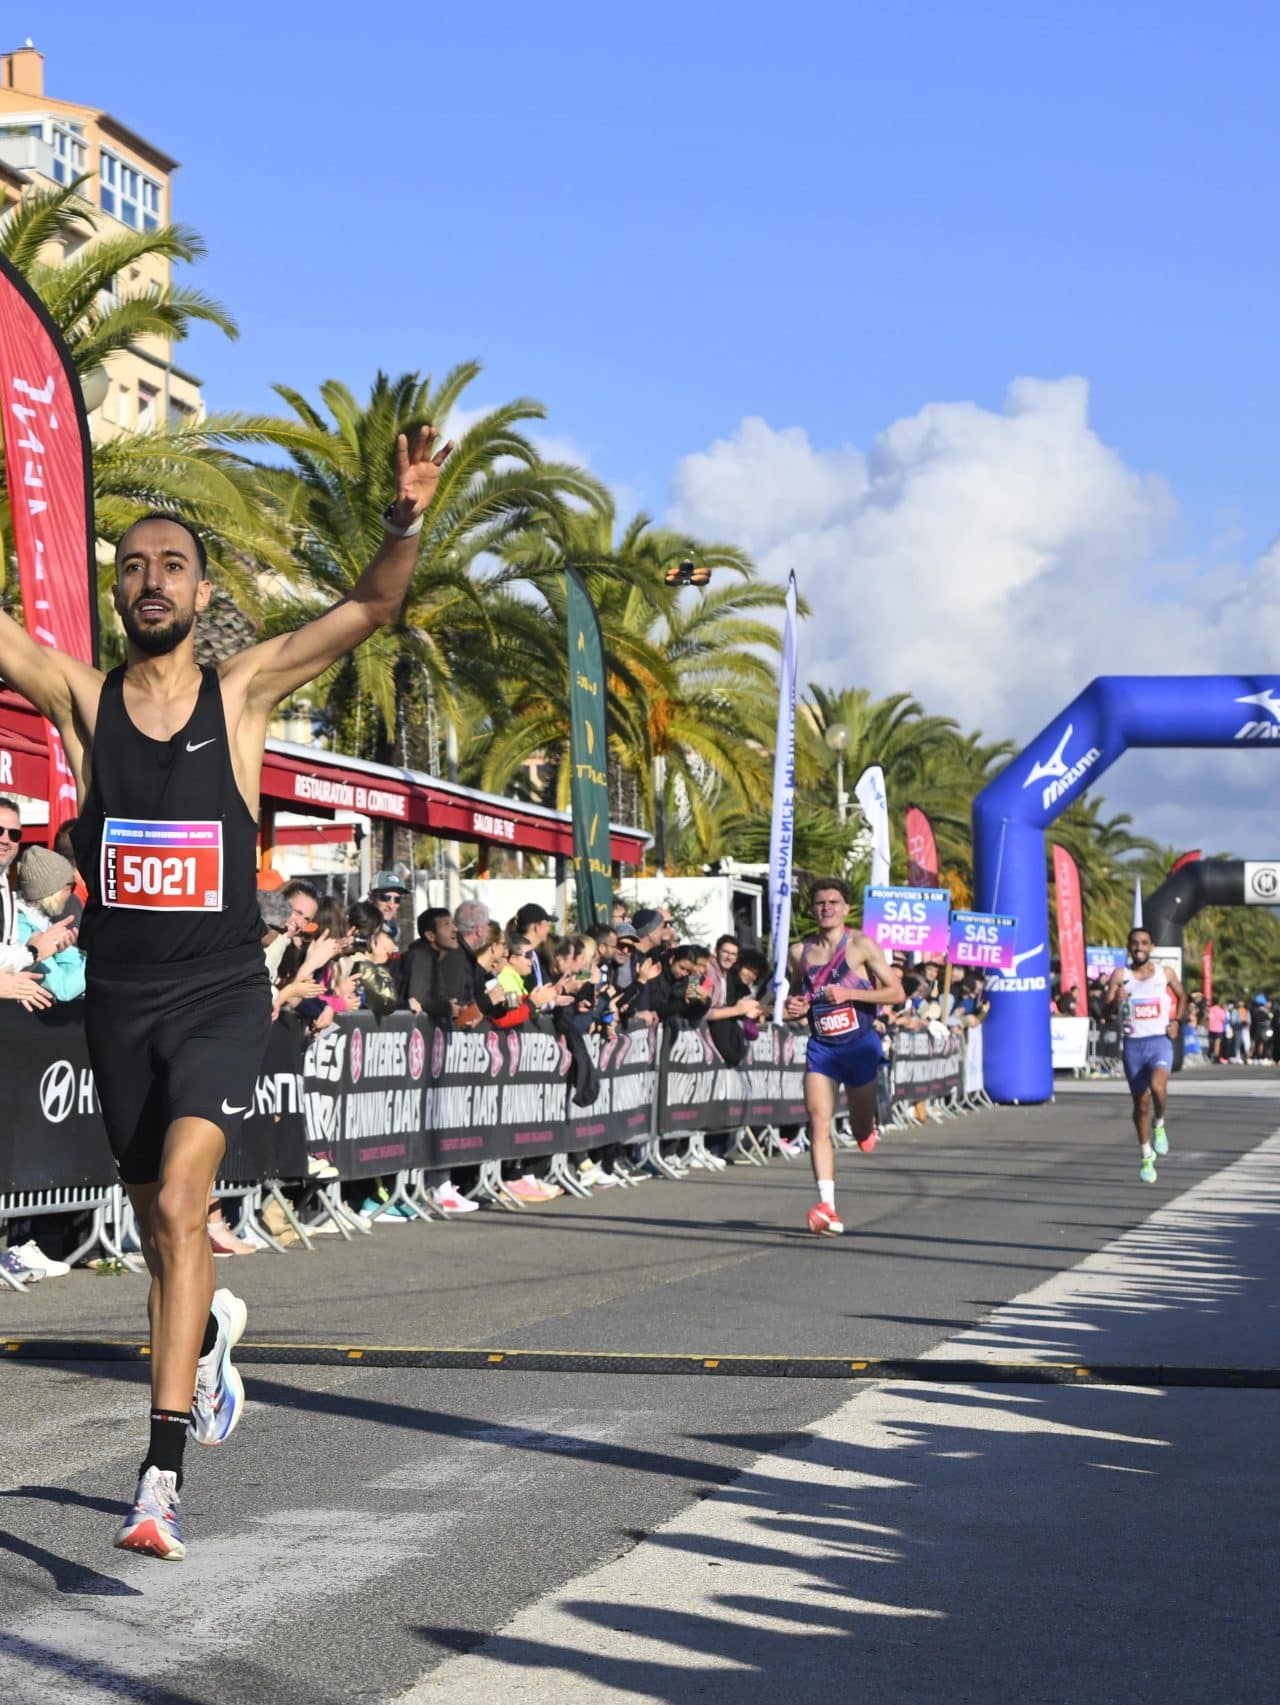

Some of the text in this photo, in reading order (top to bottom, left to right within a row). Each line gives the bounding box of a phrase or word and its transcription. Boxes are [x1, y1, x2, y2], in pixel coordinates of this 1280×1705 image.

[295, 774, 406, 817] RESTAURATION EN CONTINUE
[107, 847, 117, 901] ELITE
[123, 855, 197, 896] 5021
[883, 901, 927, 923] SAS
[876, 923, 931, 945] PREF
[964, 925, 999, 944] SAS
[956, 943, 1002, 964] ELITE
[820, 1013, 850, 1031] 5005
[344, 1089, 393, 1140] RUNNING
[425, 1085, 472, 1131] RUNNING
